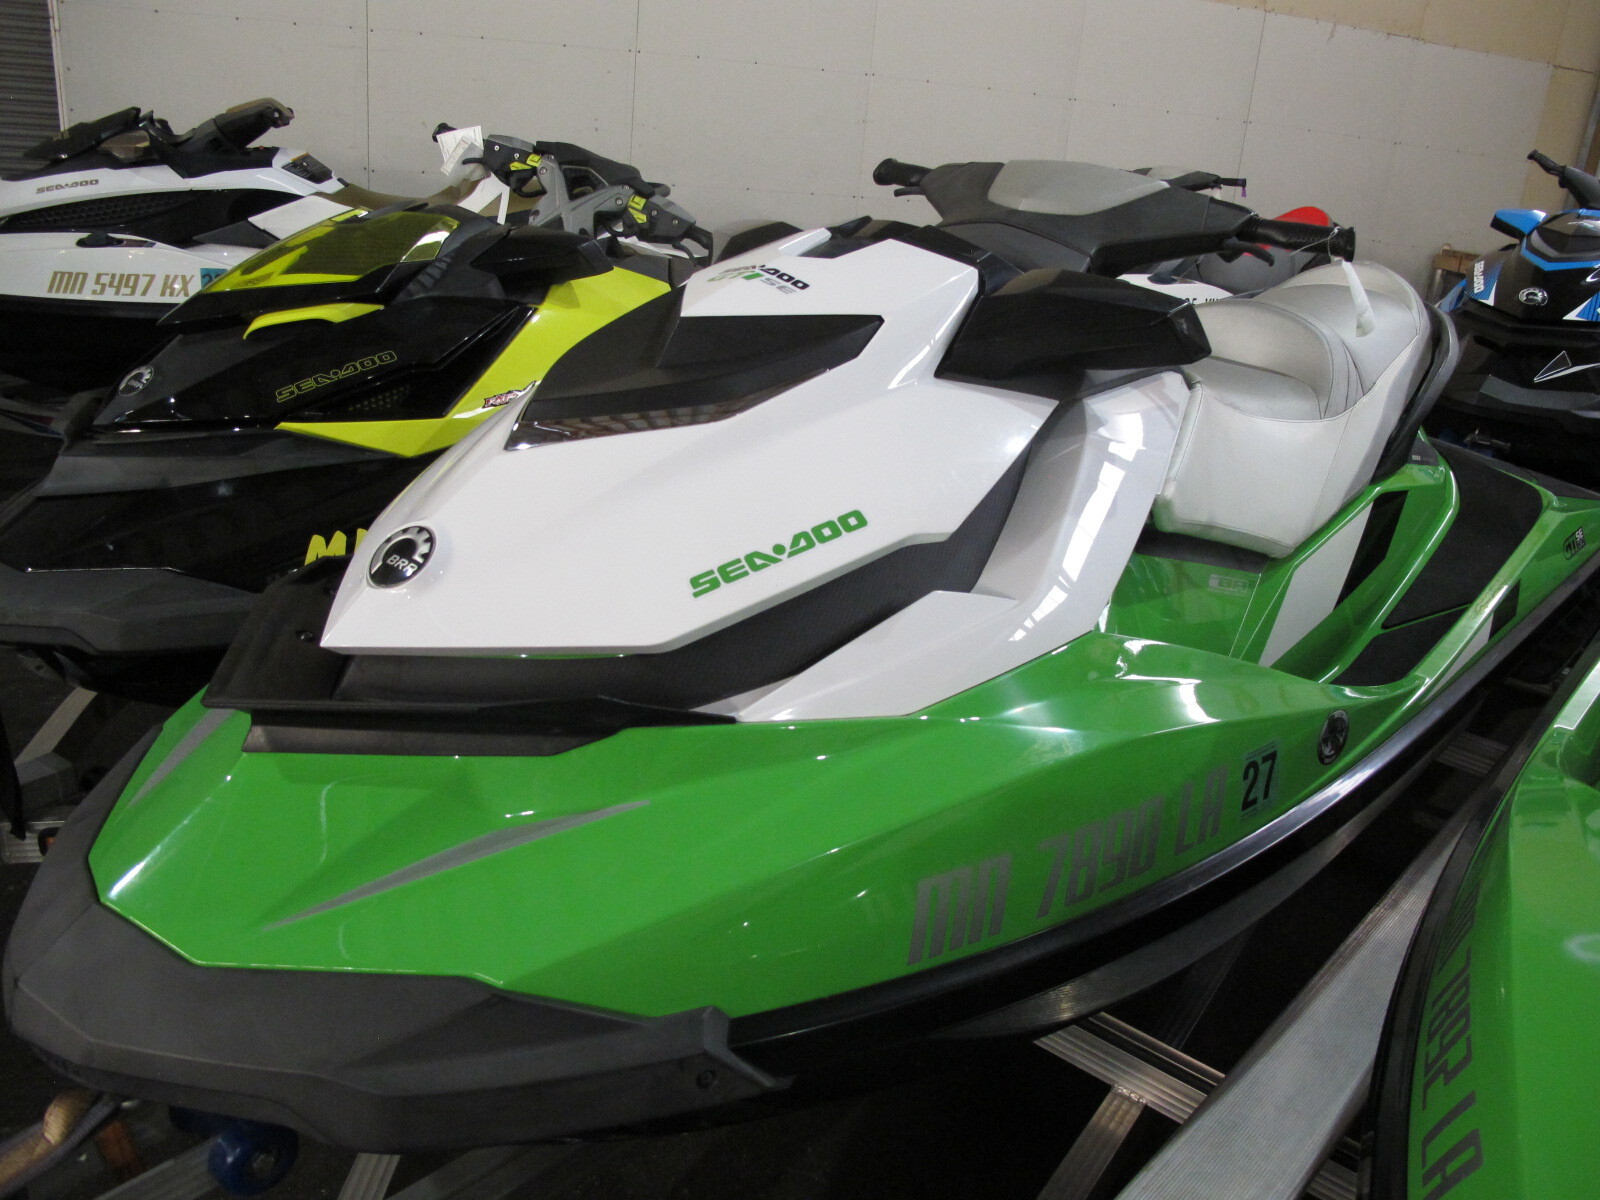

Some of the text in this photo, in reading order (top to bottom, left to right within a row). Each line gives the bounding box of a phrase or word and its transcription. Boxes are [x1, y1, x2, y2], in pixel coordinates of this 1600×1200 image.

[47, 271, 195, 297] MN 5497 KX
[1242, 750, 1277, 811] 27
[908, 764, 1229, 966] MN 7890 LA
